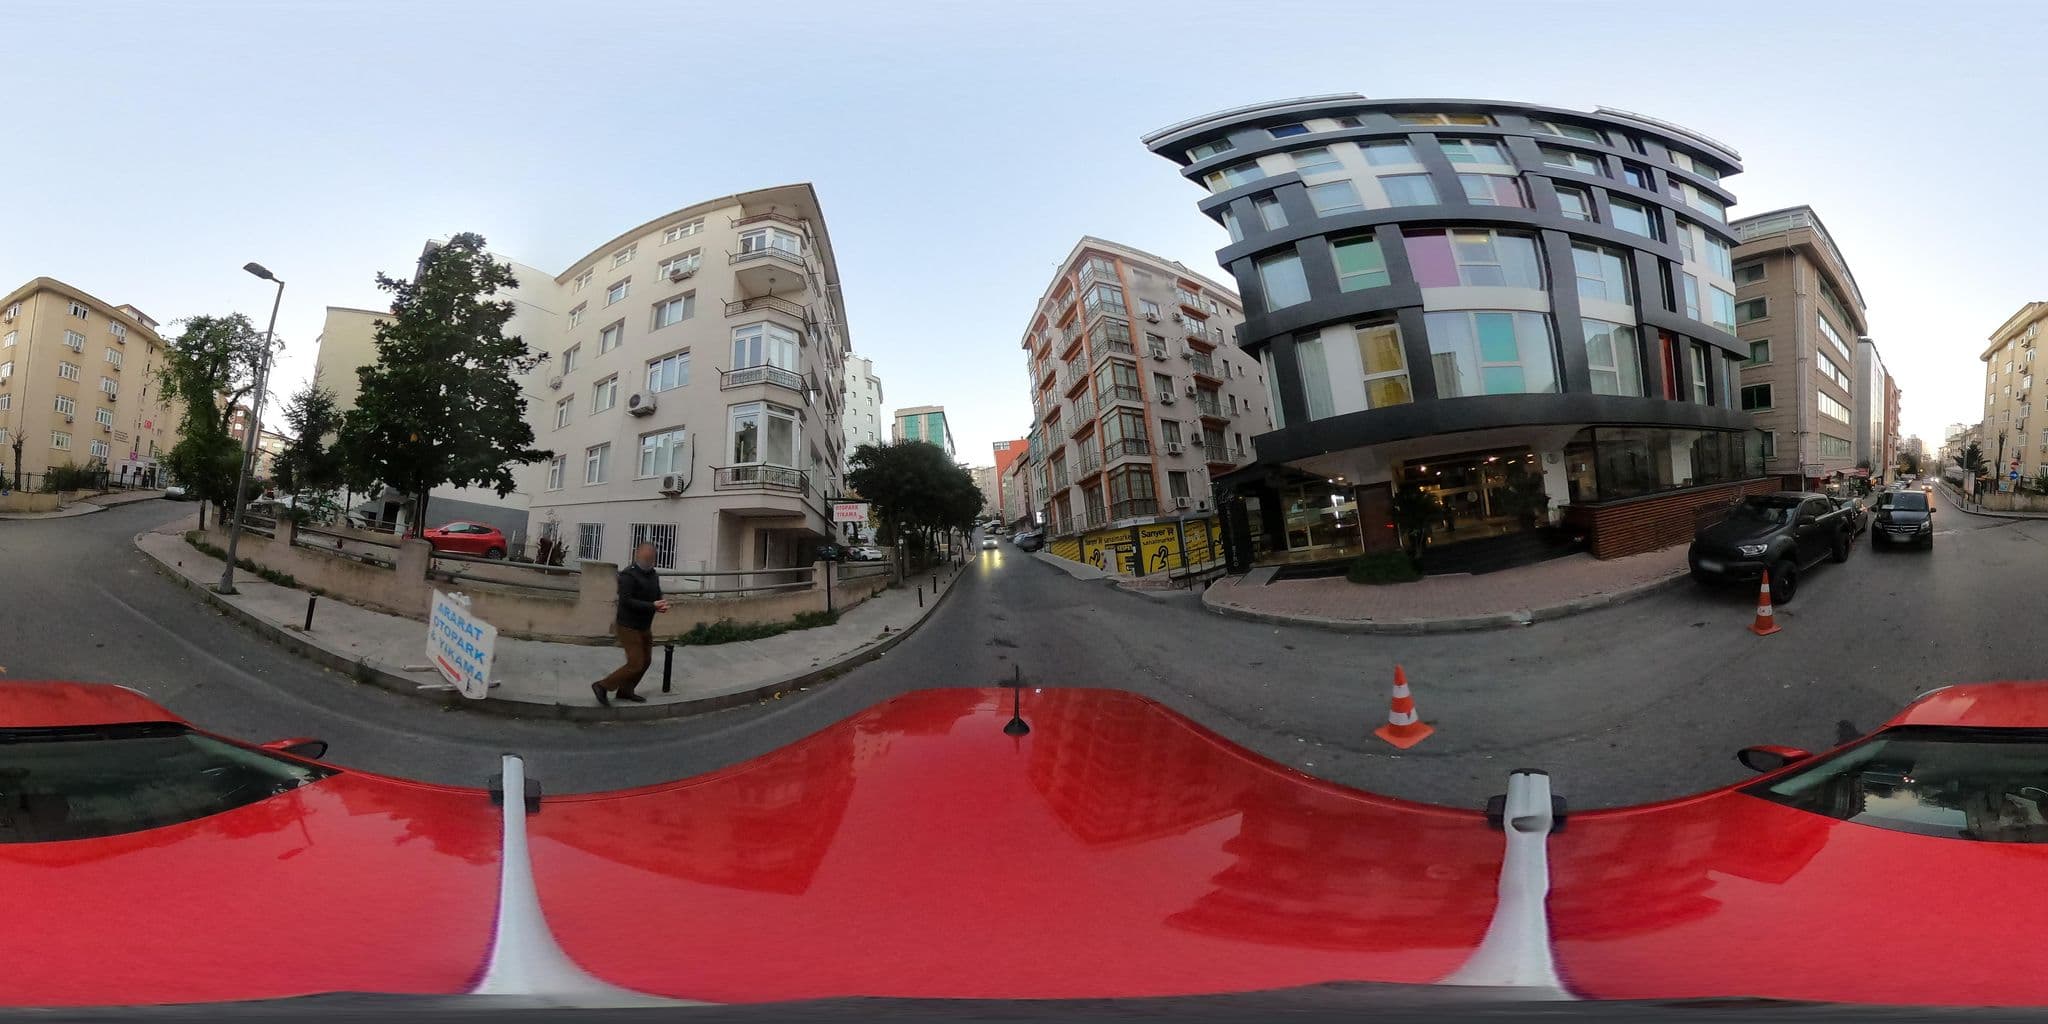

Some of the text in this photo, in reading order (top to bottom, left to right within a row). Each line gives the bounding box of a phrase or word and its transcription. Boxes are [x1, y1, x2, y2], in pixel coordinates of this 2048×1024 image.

[433, 616, 486, 665] OTOPARK
[438, 603, 484, 641] ARARAT
[439, 638, 484, 684] YIKAMA
